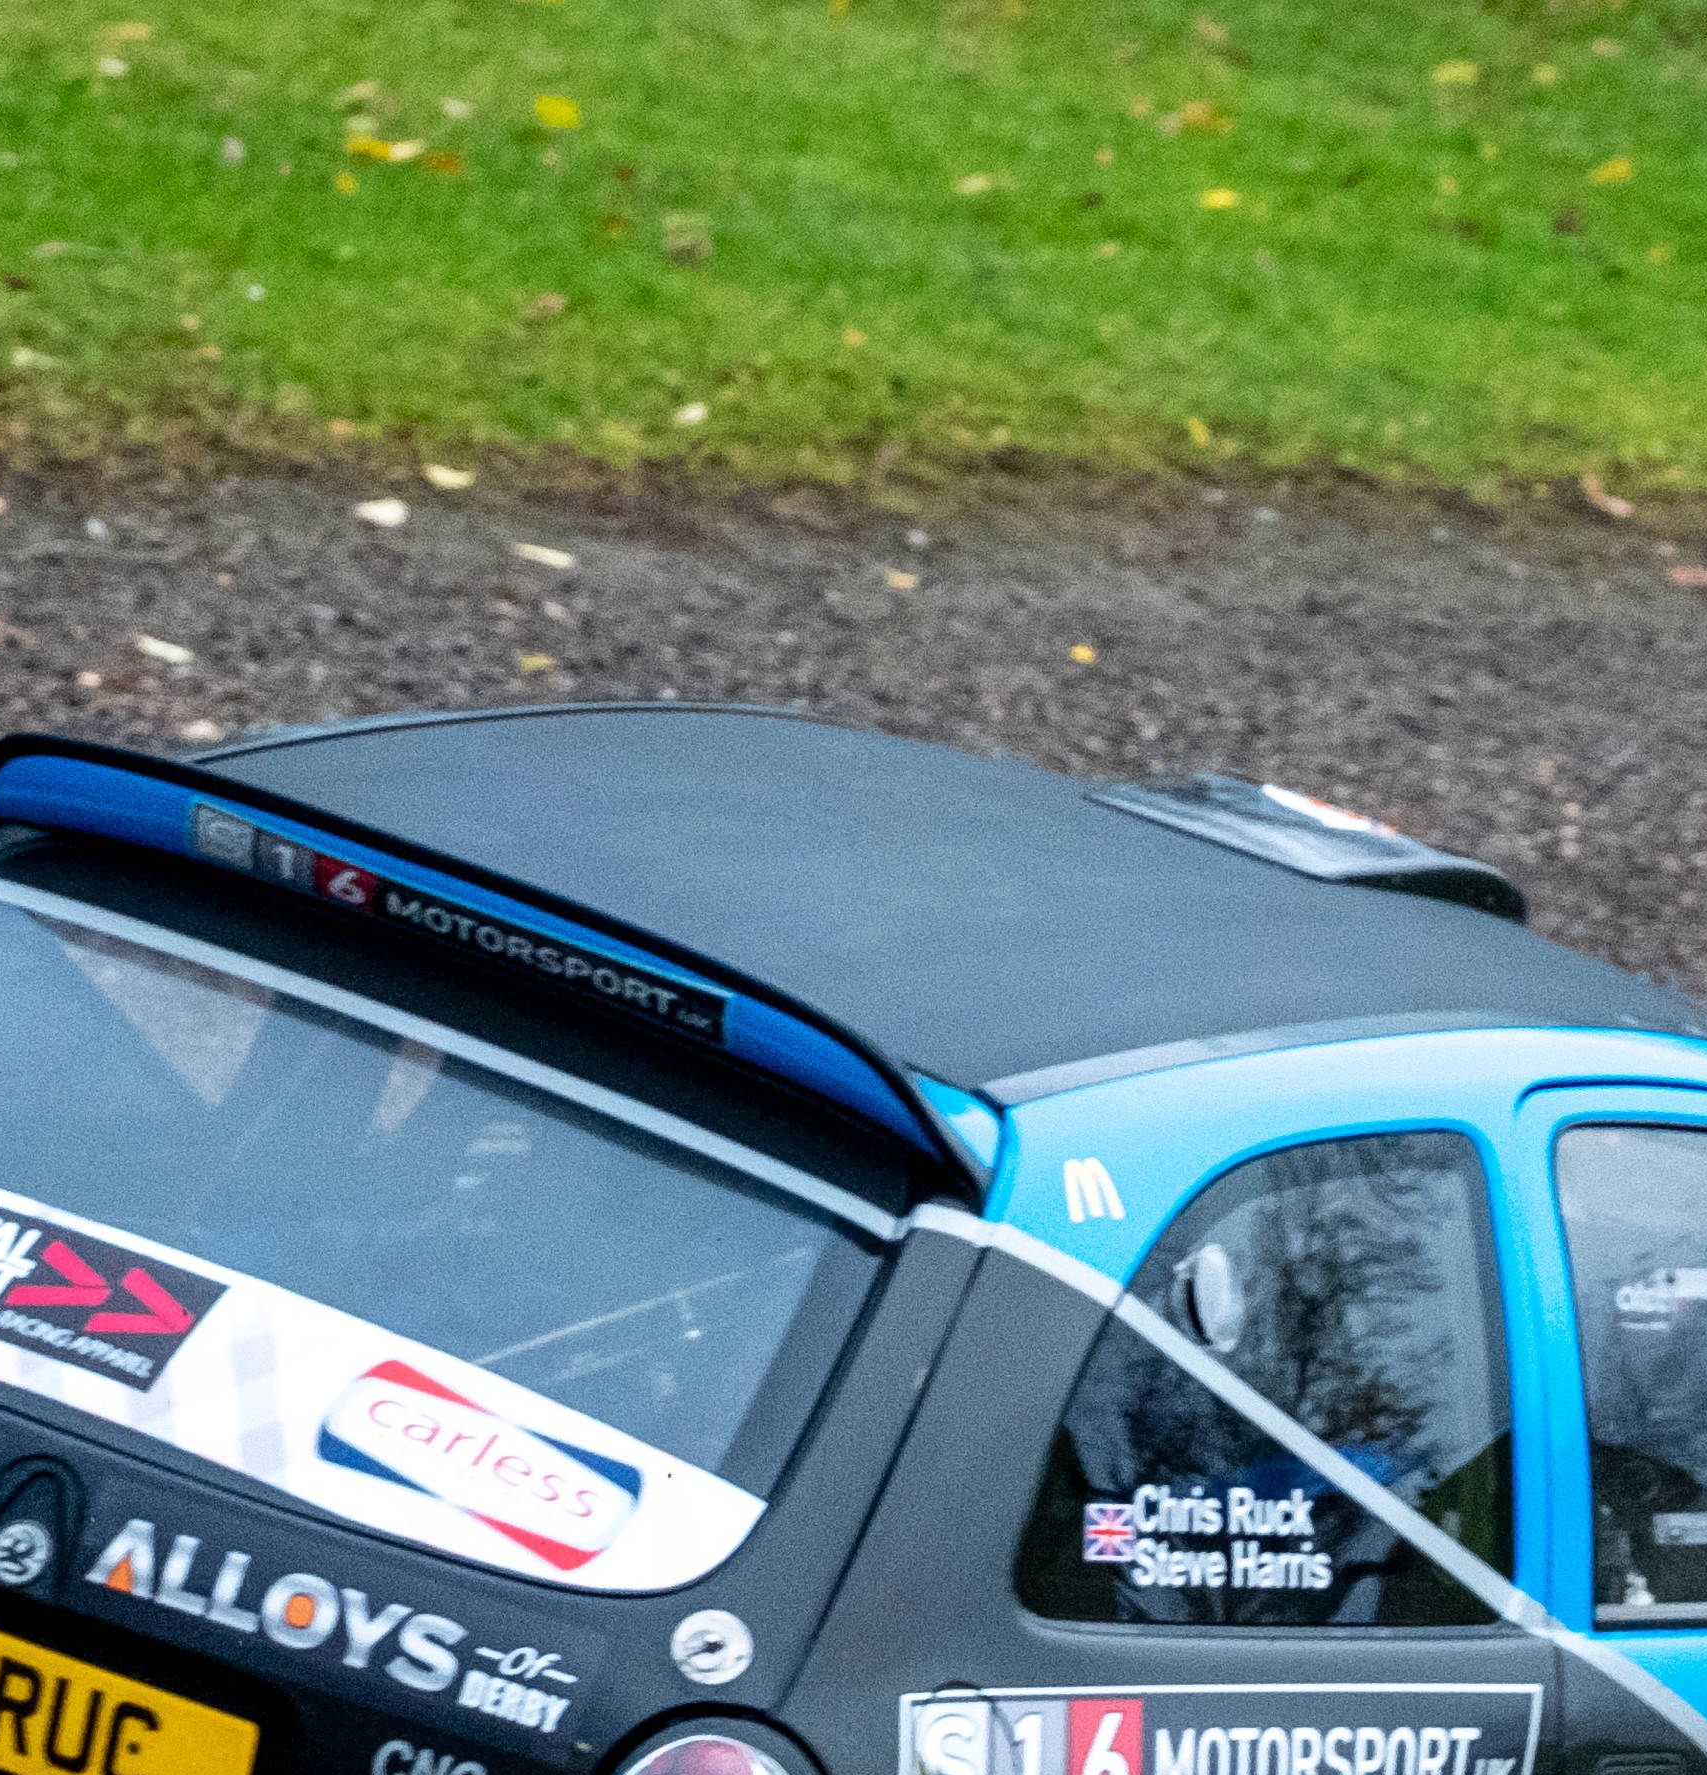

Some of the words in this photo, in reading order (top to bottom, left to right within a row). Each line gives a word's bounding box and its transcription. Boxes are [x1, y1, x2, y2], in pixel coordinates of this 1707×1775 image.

[367, 1398, 600, 1519] carless
[1134, 1483, 1223, 1535] Chris
[1227, 1486, 1316, 1537] Ruck
[1131, 1537, 1228, 1588] Steve
[1230, 1540, 1334, 1590] Harris
[85, 1518, 469, 1692] ALLOYS
[457, 1669, 571, 1733] DERBY
